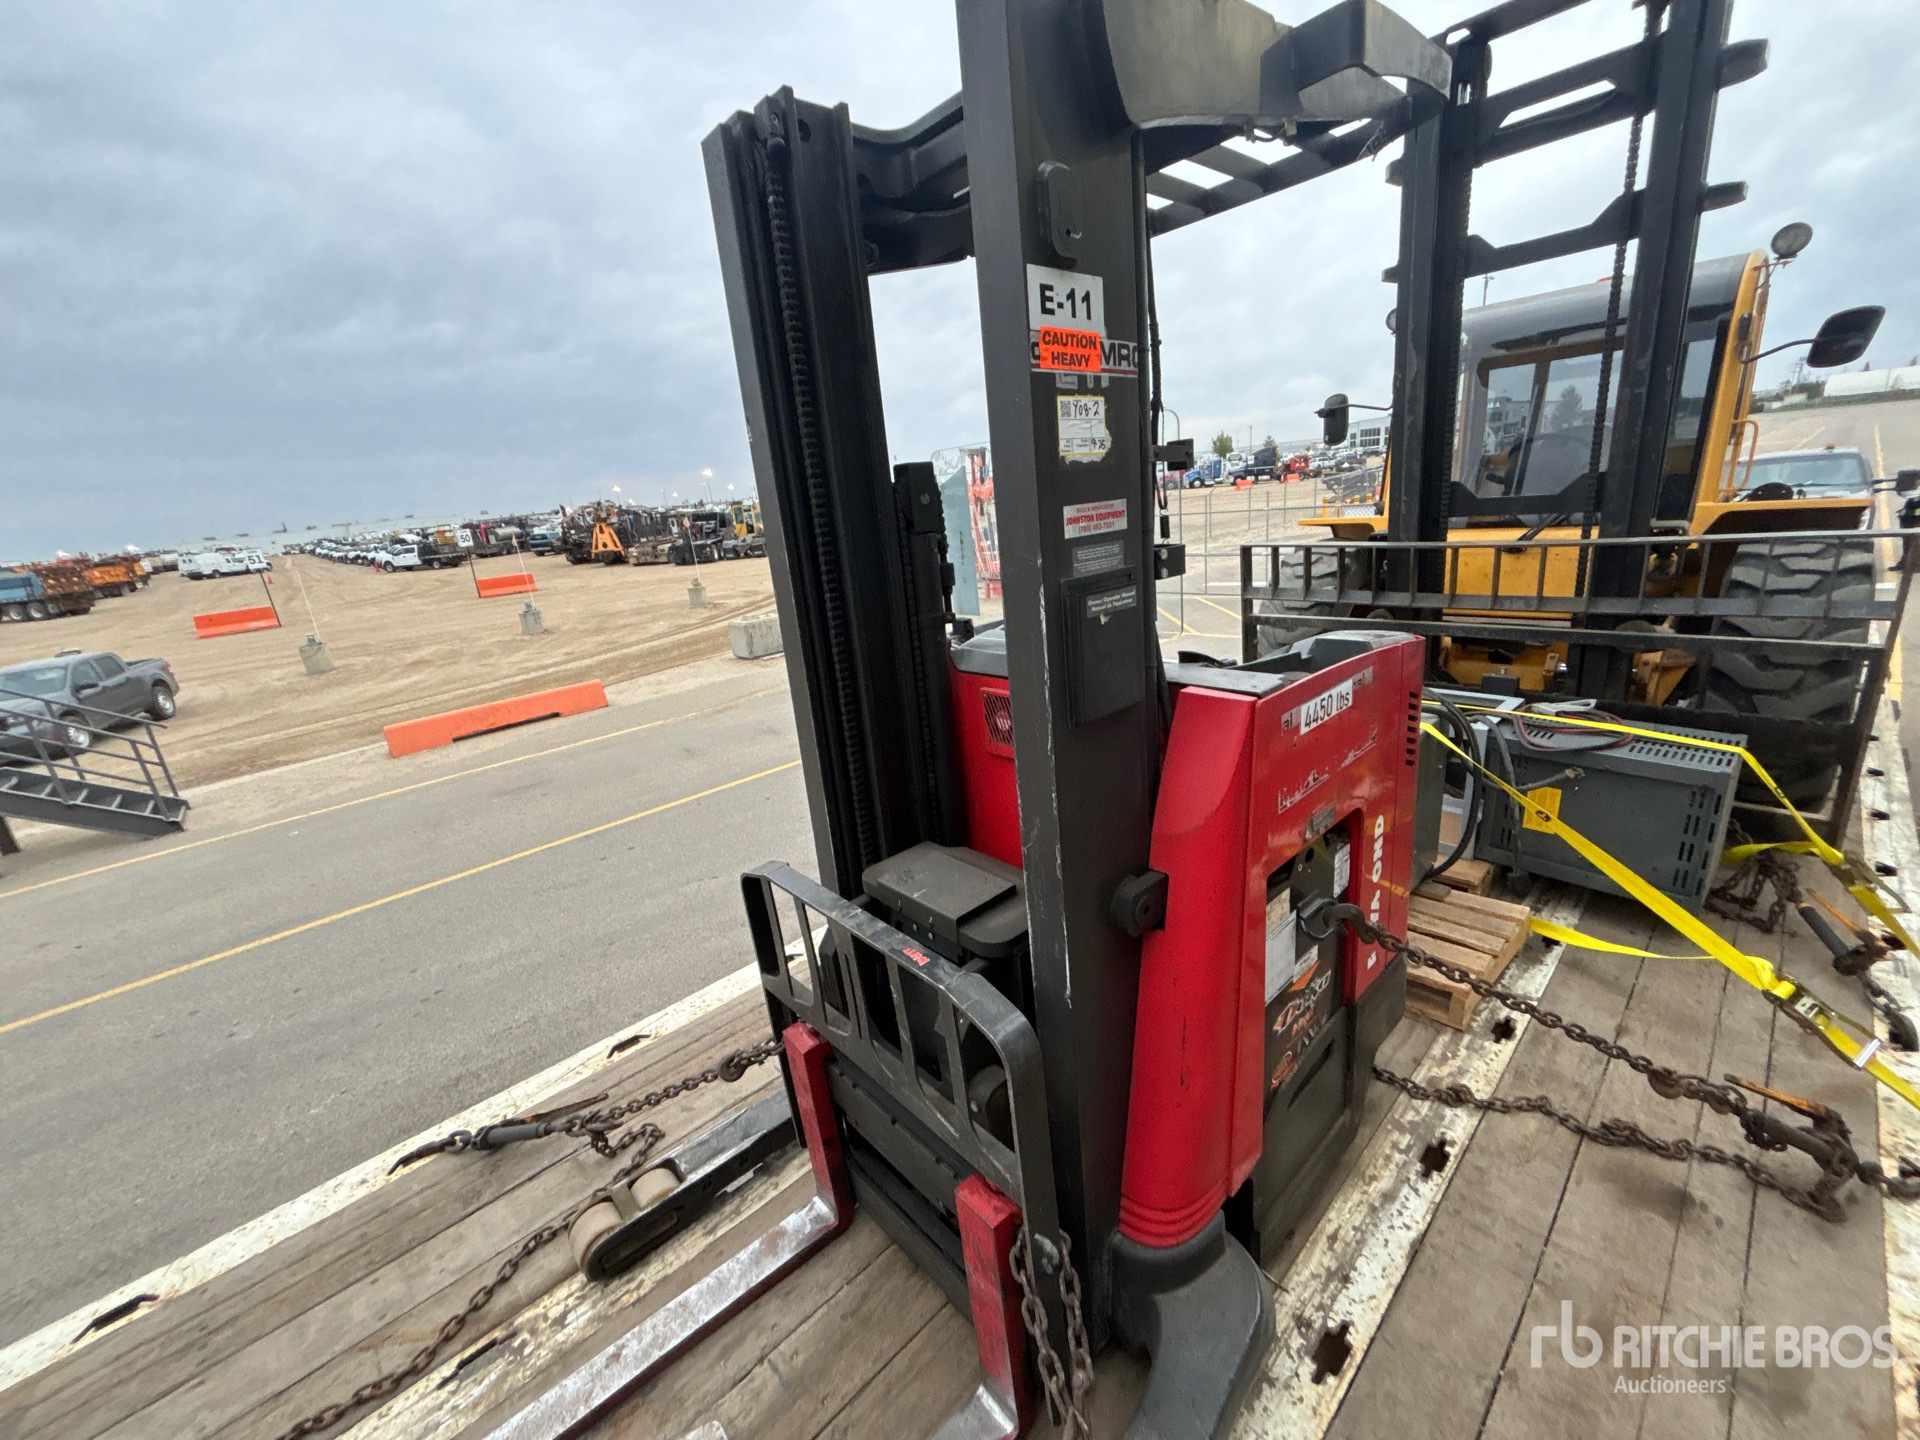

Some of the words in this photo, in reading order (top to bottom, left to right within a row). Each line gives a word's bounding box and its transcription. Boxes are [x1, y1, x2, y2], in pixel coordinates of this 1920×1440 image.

[1039, 283, 1092, 321] E-11
[1042, 330, 1098, 350] CAUTION
[1051, 351, 1091, 368] HEAVY
[1066, 514, 1095, 526] JOHNSTON
[1095, 510, 1126, 521] EQUIPMENT
[460, 534, 471, 543] 50
[247, 555, 264, 565] 51
[1304, 693, 1333, 729] 4450
[1336, 691, 1350, 712] lbs
